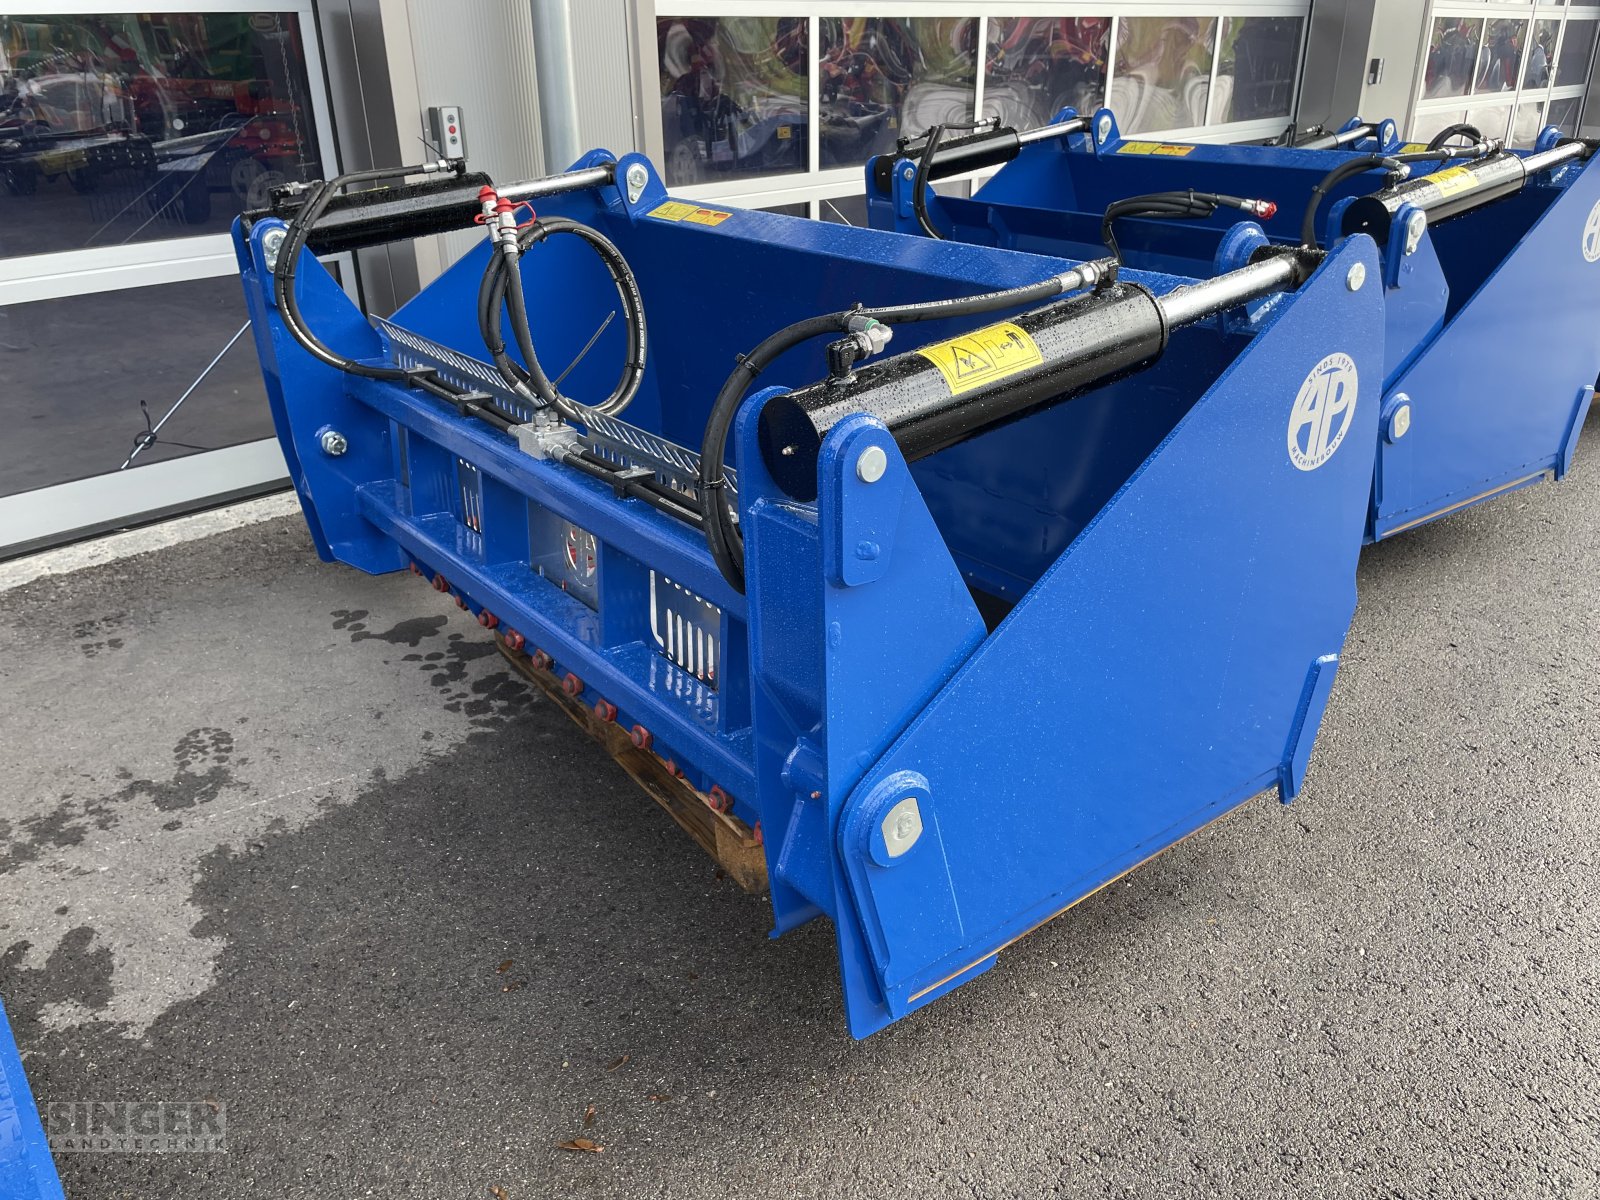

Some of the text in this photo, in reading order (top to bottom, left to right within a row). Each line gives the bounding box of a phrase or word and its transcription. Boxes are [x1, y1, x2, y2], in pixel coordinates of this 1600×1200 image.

[1308, 356, 1353, 384] SINDS 1979
[1291, 431, 1343, 467] MACHINEBOUW
